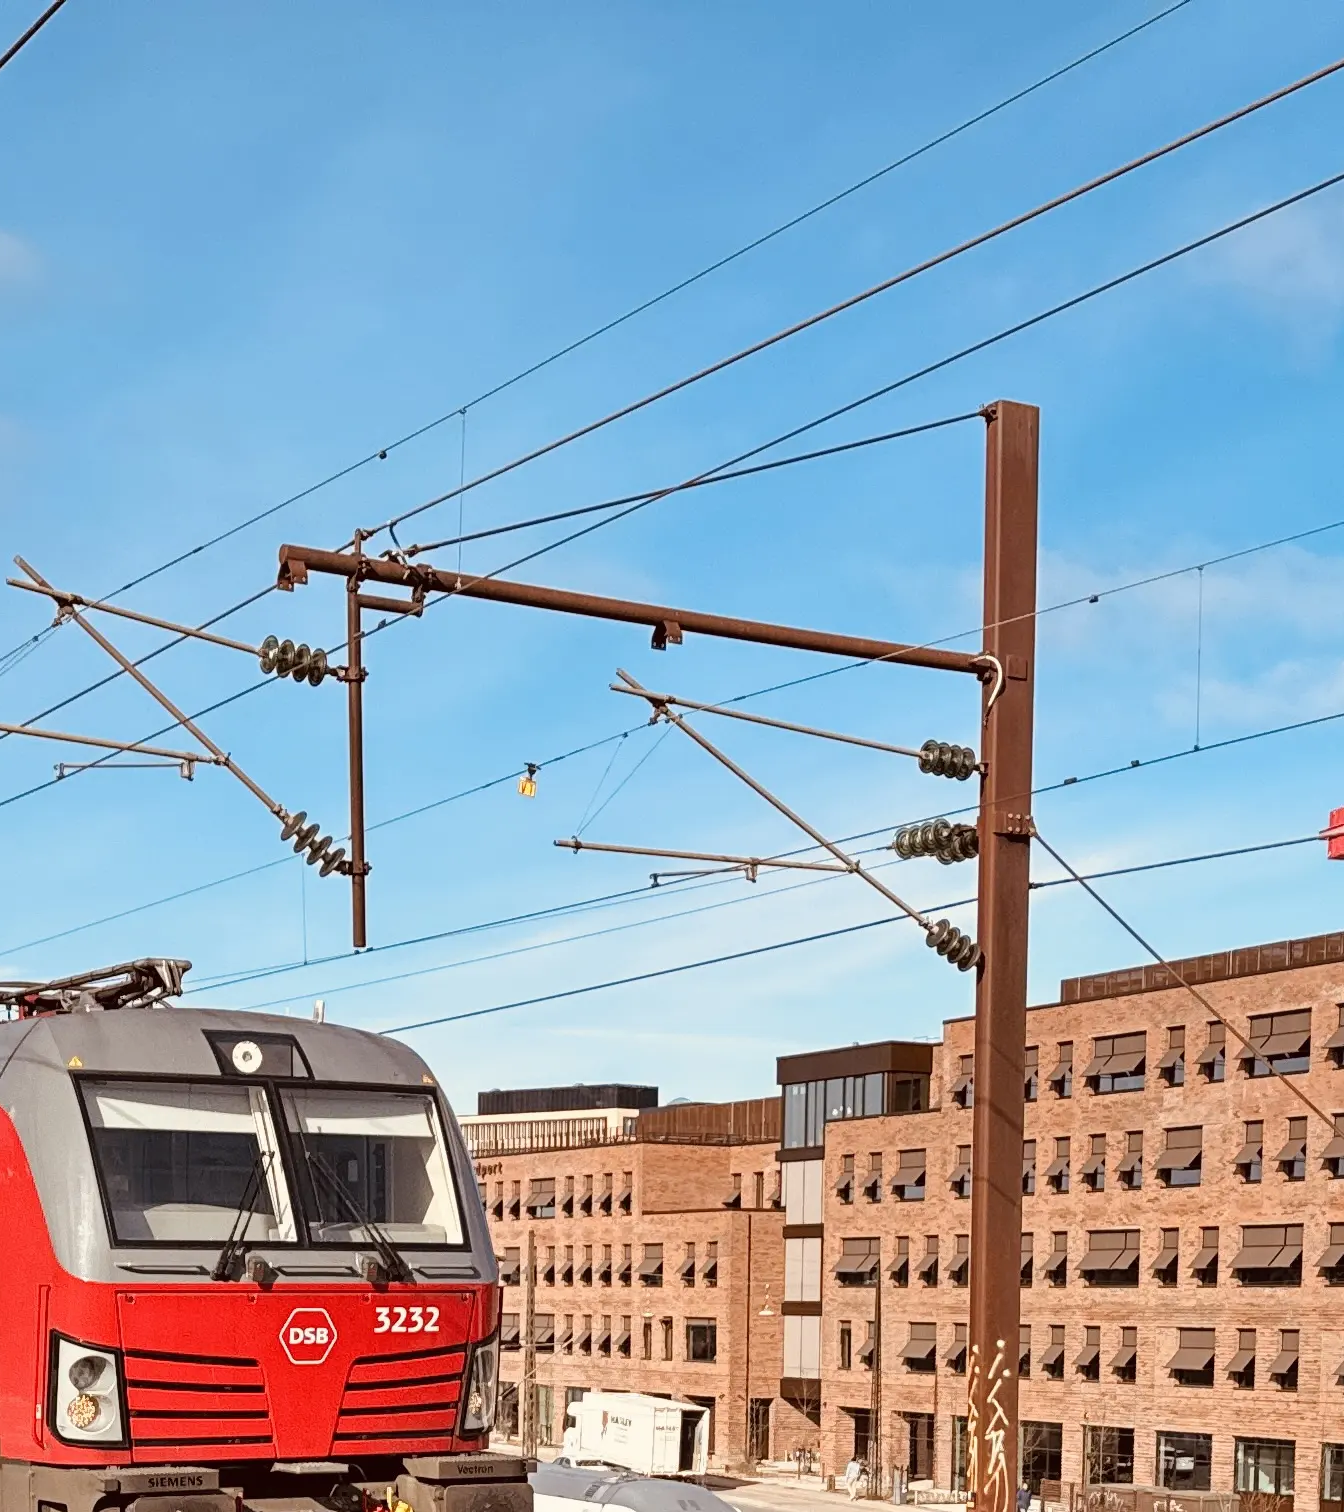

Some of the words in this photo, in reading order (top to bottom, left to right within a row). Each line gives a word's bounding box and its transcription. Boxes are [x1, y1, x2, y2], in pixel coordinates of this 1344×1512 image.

[373, 1306, 440, 1333] 3232
[288, 1327, 329, 1345] DSB
[456, 1464, 494, 1474] Vectron
[147, 1475, 204, 1488] SIEMENS
